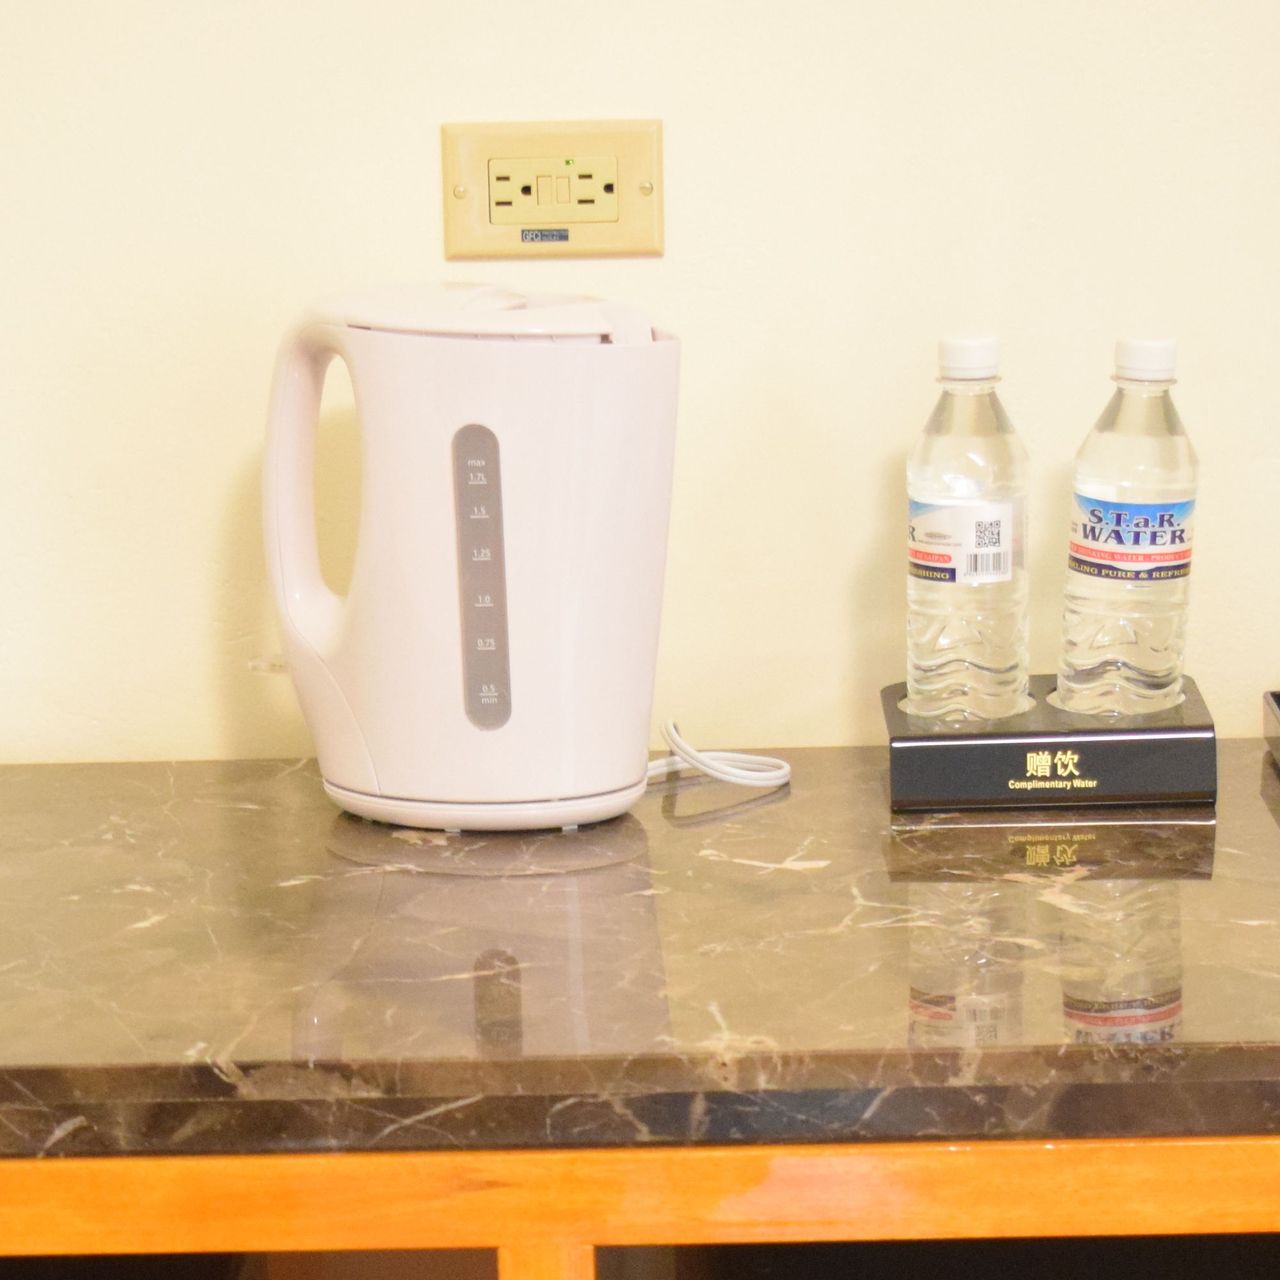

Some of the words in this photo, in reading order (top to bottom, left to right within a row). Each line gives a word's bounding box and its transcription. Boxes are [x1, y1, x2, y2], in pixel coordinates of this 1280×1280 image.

[523, 231, 542, 241] GFCI
[468, 459, 486, 468] max
[473, 504, 487, 515] 1.5
[1088, 508, 1181, 529] S.T.a.R.
[1081, 523, 1185, 546] WATER
[473, 548, 491, 559] 1.25
[1101, 568, 1135, 578] PURE
[1139, 571, 1148, 579] &
[478, 595, 492, 604] 1.0
[477, 639, 496, 649] 0.75
[481, 684, 496, 693] 0.5
[481, 696, 498, 705] min
[1026, 750, 1080, 777] 赠饮
[1008, 780, 1071, 790] Complimentary
[1072, 779, 1097, 789] Water
